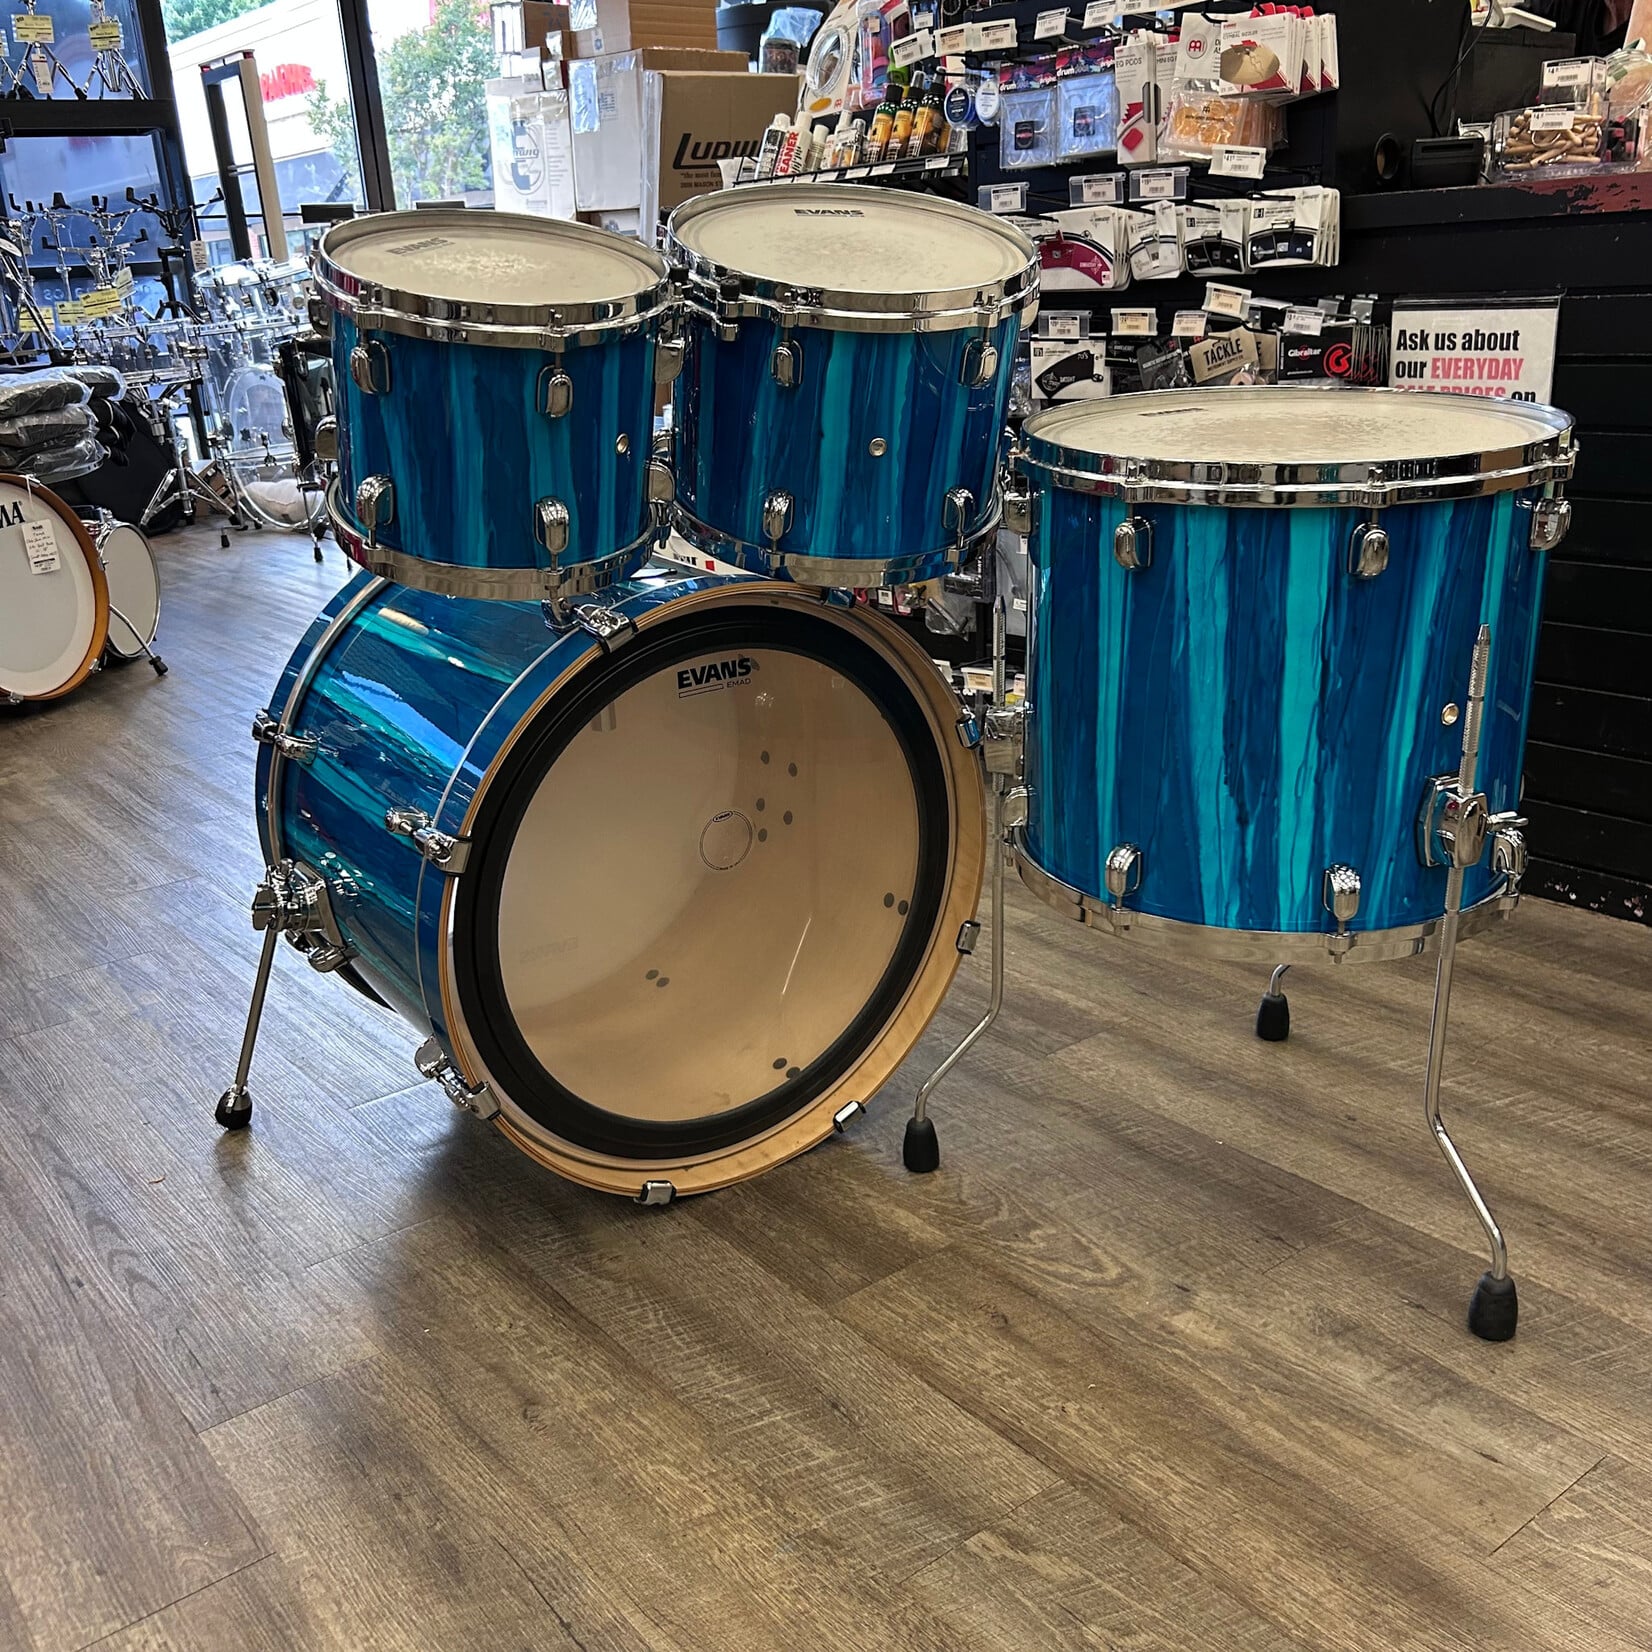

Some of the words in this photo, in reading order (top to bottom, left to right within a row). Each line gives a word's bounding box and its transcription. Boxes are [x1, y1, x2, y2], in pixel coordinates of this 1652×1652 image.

[672, 132, 766, 170] LUDW
[780, 131, 799, 174] EANER
[1203, 337, 1243, 366] TACKLE
[1287, 348, 1322, 358] Gibraltar
[1396, 329, 1430, 351] Ask
[1434, 332, 1457, 351] us
[1461, 329, 1520, 351] about
[1395, 360, 1427, 379] our
[1430, 357, 1524, 381] EVERYDAY
[0, 500, 26, 529] MA
[677, 657, 752, 690] EVANS
[726, 678, 752, 689] EMAD
